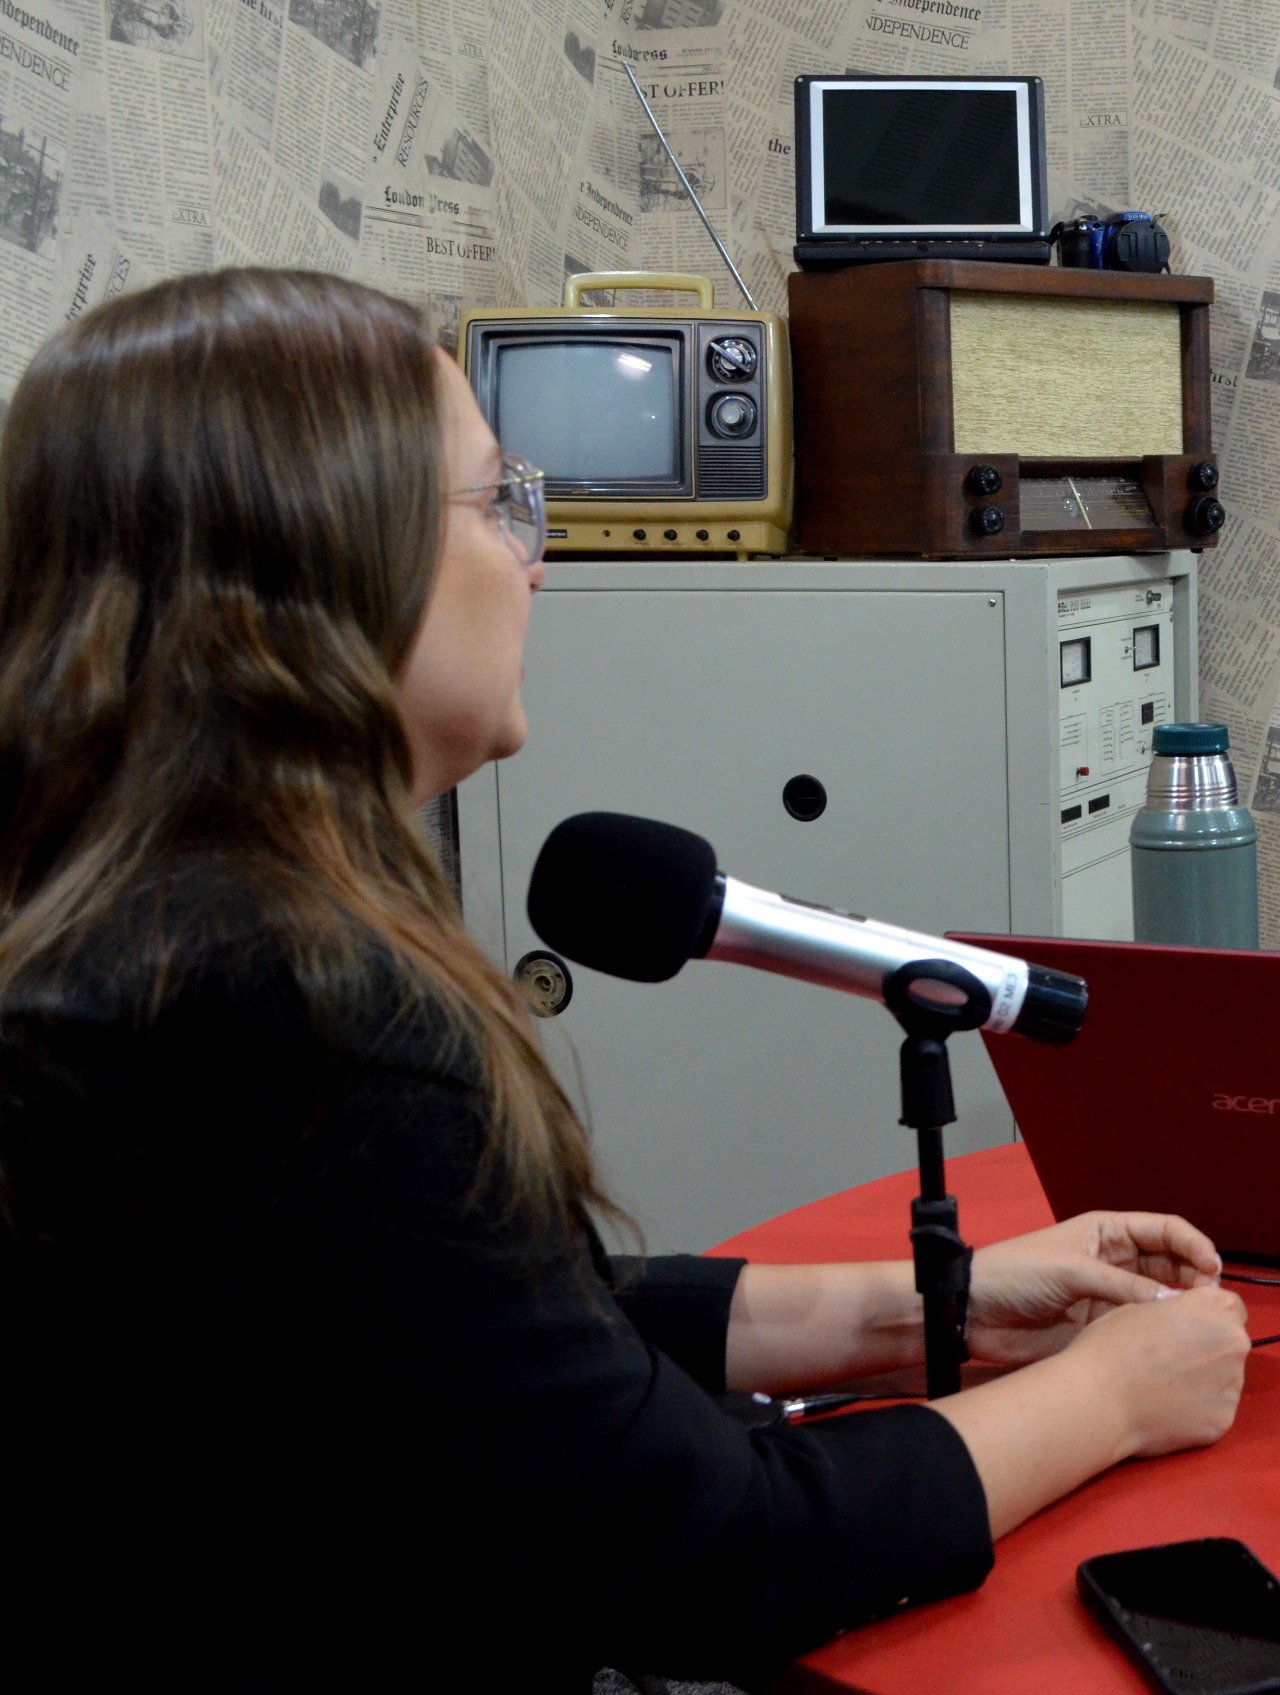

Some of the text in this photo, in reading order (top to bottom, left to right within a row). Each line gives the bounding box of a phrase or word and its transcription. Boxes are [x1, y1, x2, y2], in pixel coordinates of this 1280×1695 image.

[397, 77, 429, 168] RESOURCES
[768, 138, 791, 155] the
[426, 236, 455, 258] BEST
